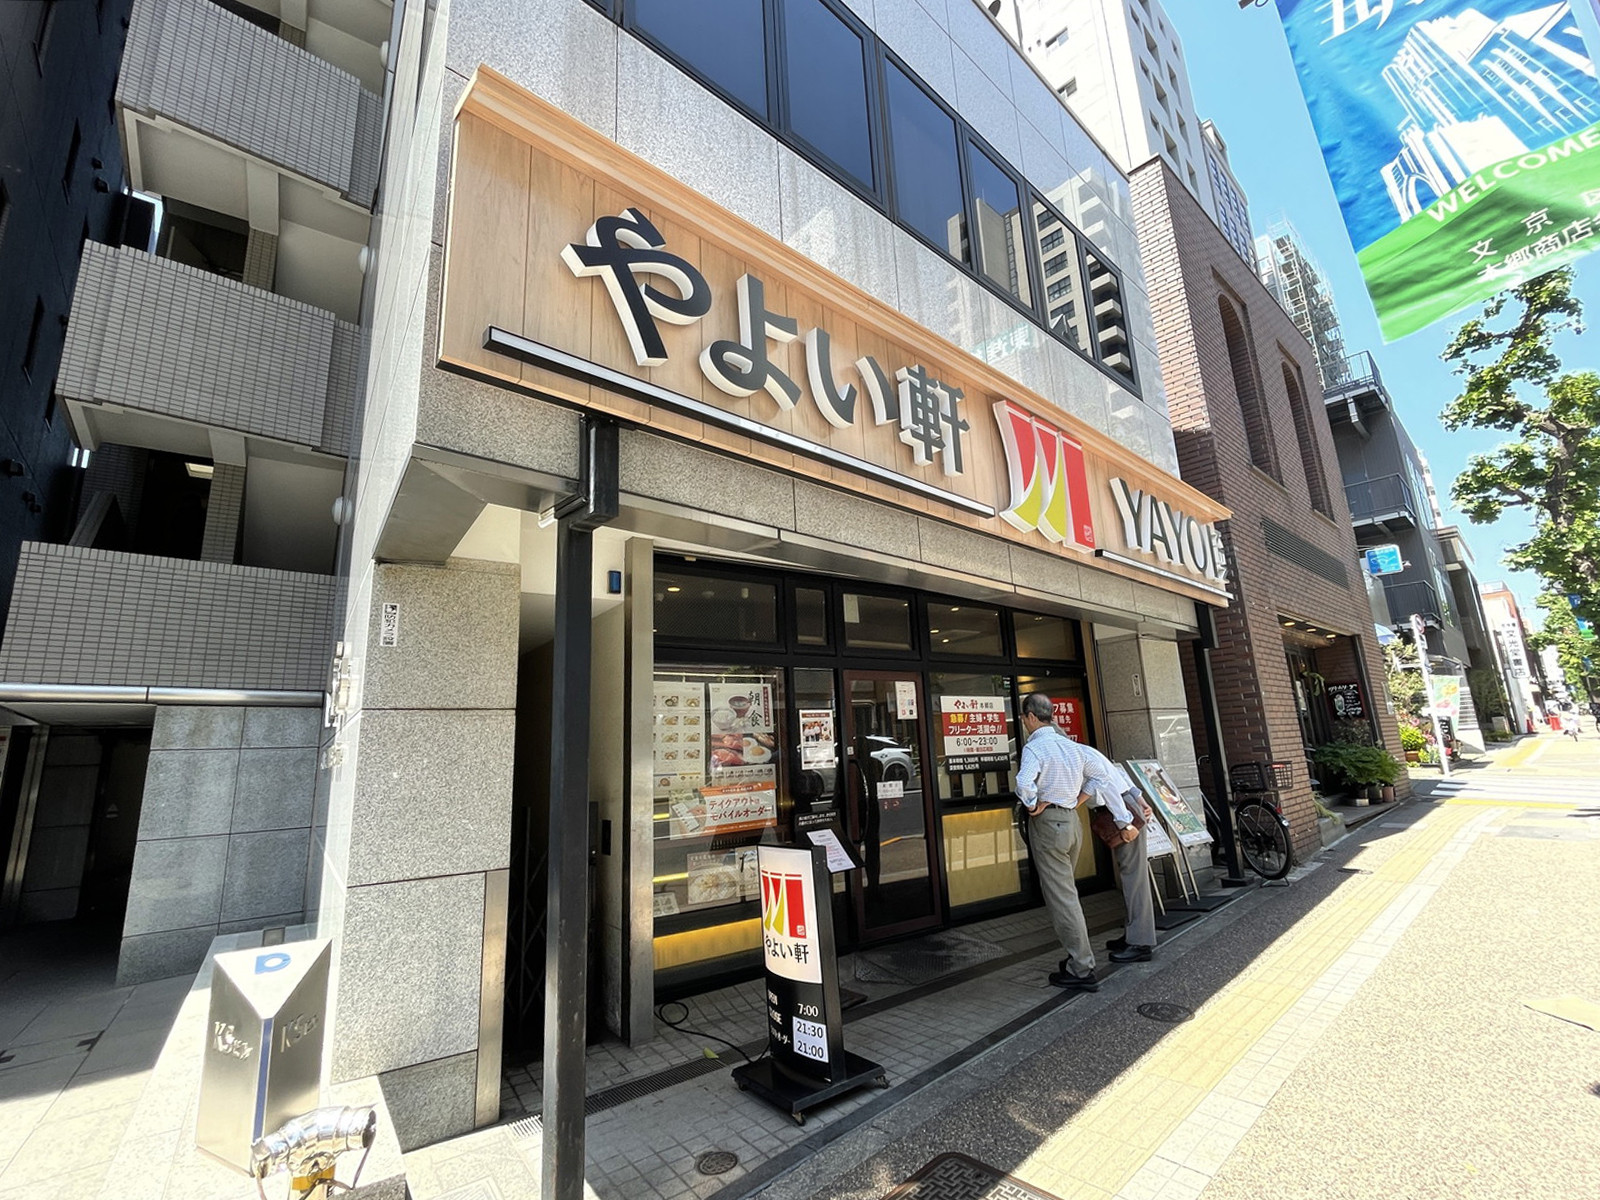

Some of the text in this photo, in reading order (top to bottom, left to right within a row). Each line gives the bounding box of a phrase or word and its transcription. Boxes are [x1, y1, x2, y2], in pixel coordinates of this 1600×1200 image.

[1426, 127, 1600, 223] WELCOME
[1477, 213, 1600, 283] 本郷商店
[560, 207, 970, 477] やよい軒
[748, 690, 762, 727] 朝食
[765, 934, 809, 964] やよい軒
[797, 1003, 819, 1017] 7:00
[796, 1021, 823, 1039] 21:30
[797, 1041, 824, 1059] 21:00
